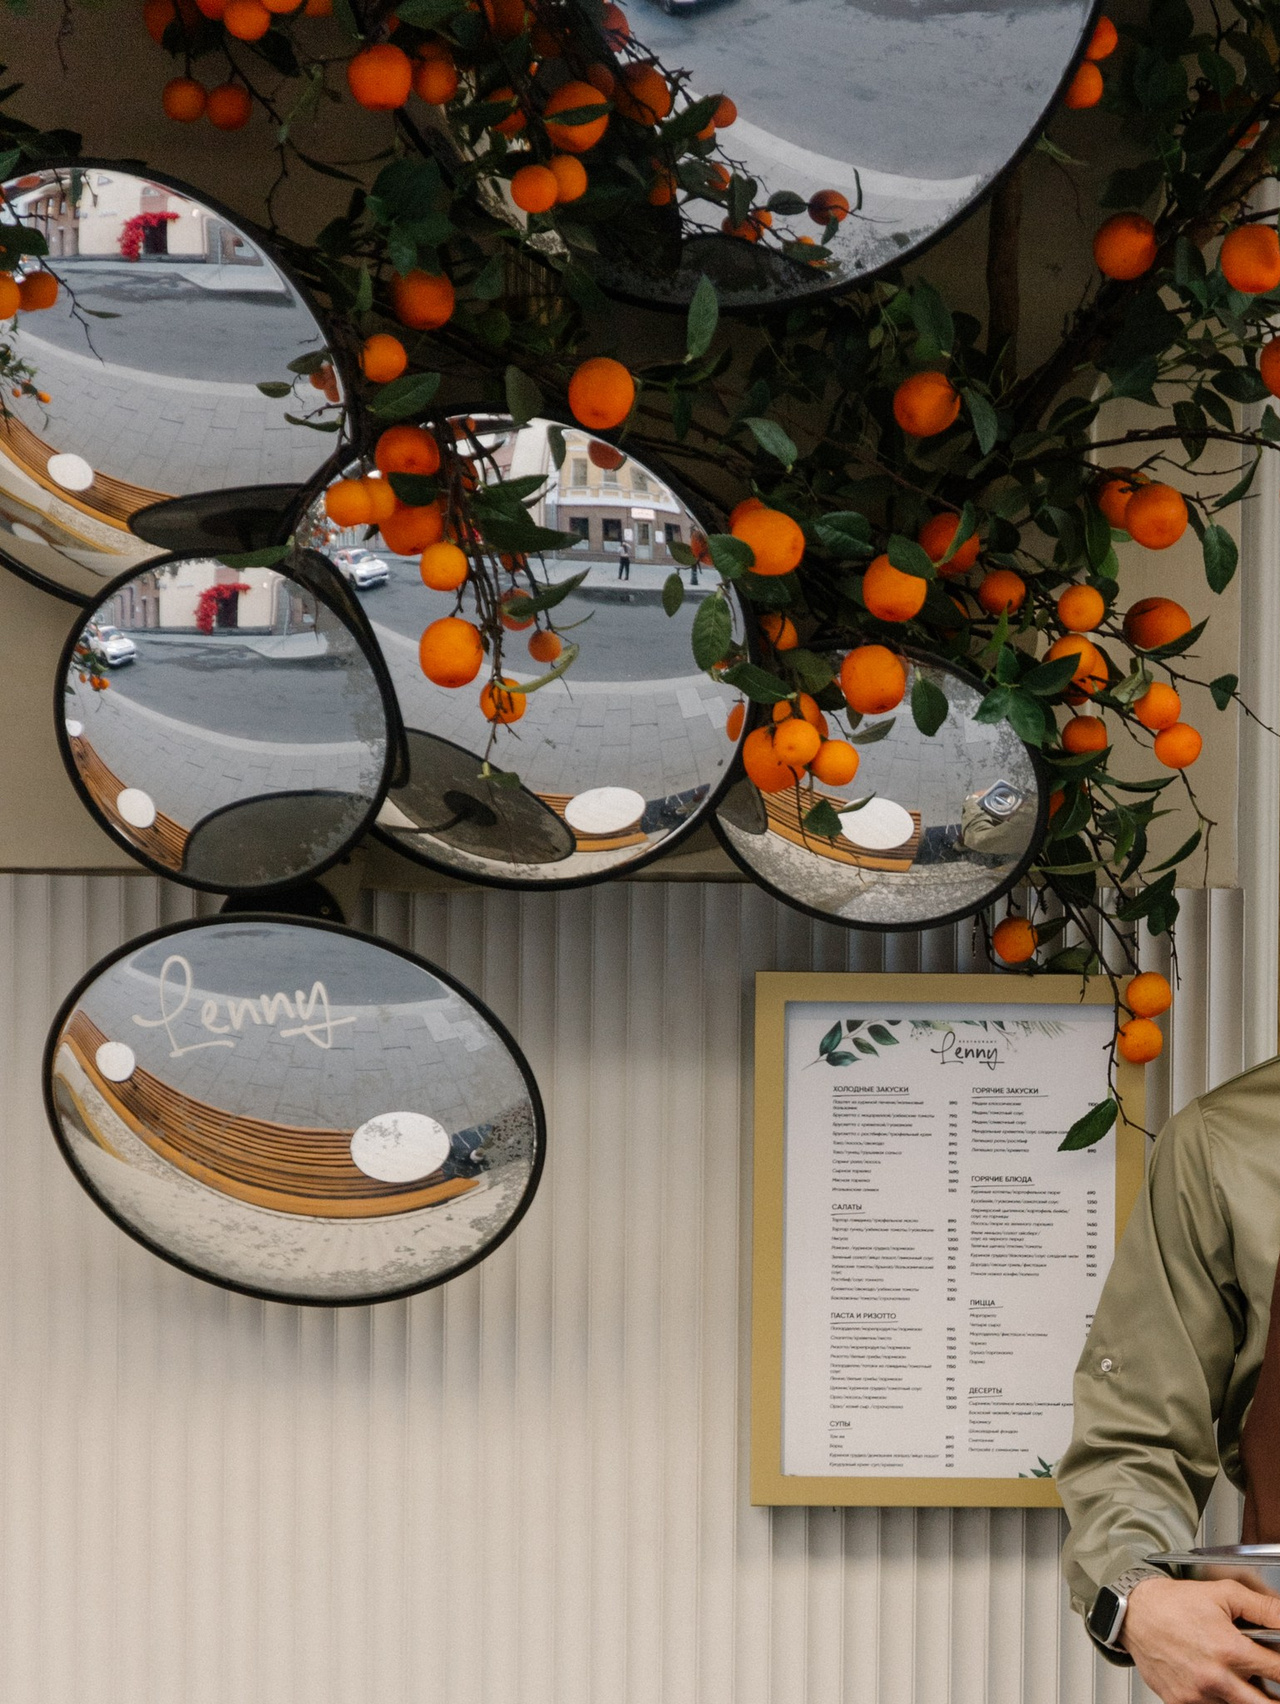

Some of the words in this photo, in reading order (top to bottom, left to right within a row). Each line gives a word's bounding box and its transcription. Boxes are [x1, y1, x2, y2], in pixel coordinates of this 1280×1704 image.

[132, 954, 358, 1058] Lenny
[930, 1031, 1005, 1071] Lenny
[833, 1085, 874, 1093] ХОЛОДНЫЕ
[971, 1175, 1003, 1183] ГОРЯЧИЕ
[1005, 1176, 1033, 1184] БЛЮДА
[831, 1203, 863, 1211] САЛАТЫ
[969, 1299, 996, 1307] ПИЦЦА
